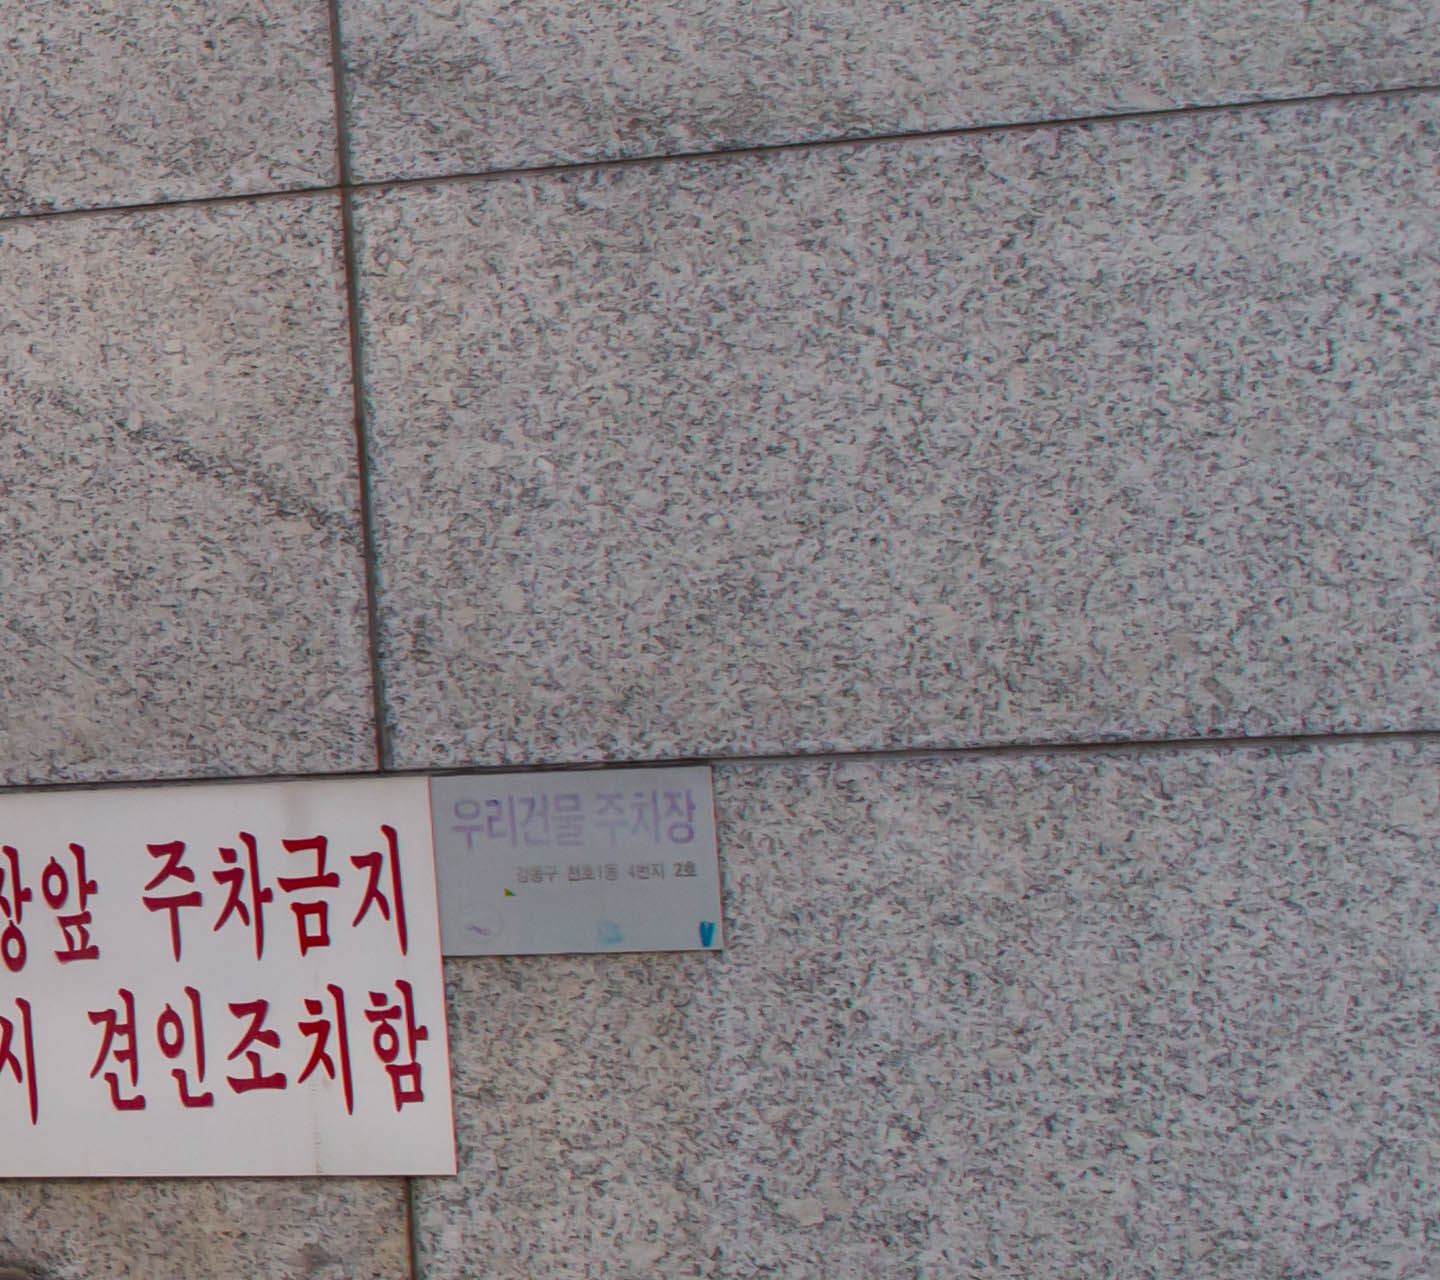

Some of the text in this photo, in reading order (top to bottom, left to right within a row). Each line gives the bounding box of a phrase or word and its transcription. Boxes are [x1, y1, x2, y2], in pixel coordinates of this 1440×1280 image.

[451, 793, 585, 850] 우리건물
[141, 824, 408, 962] 주차금지
[87, 978, 429, 1115] 견인조치함
